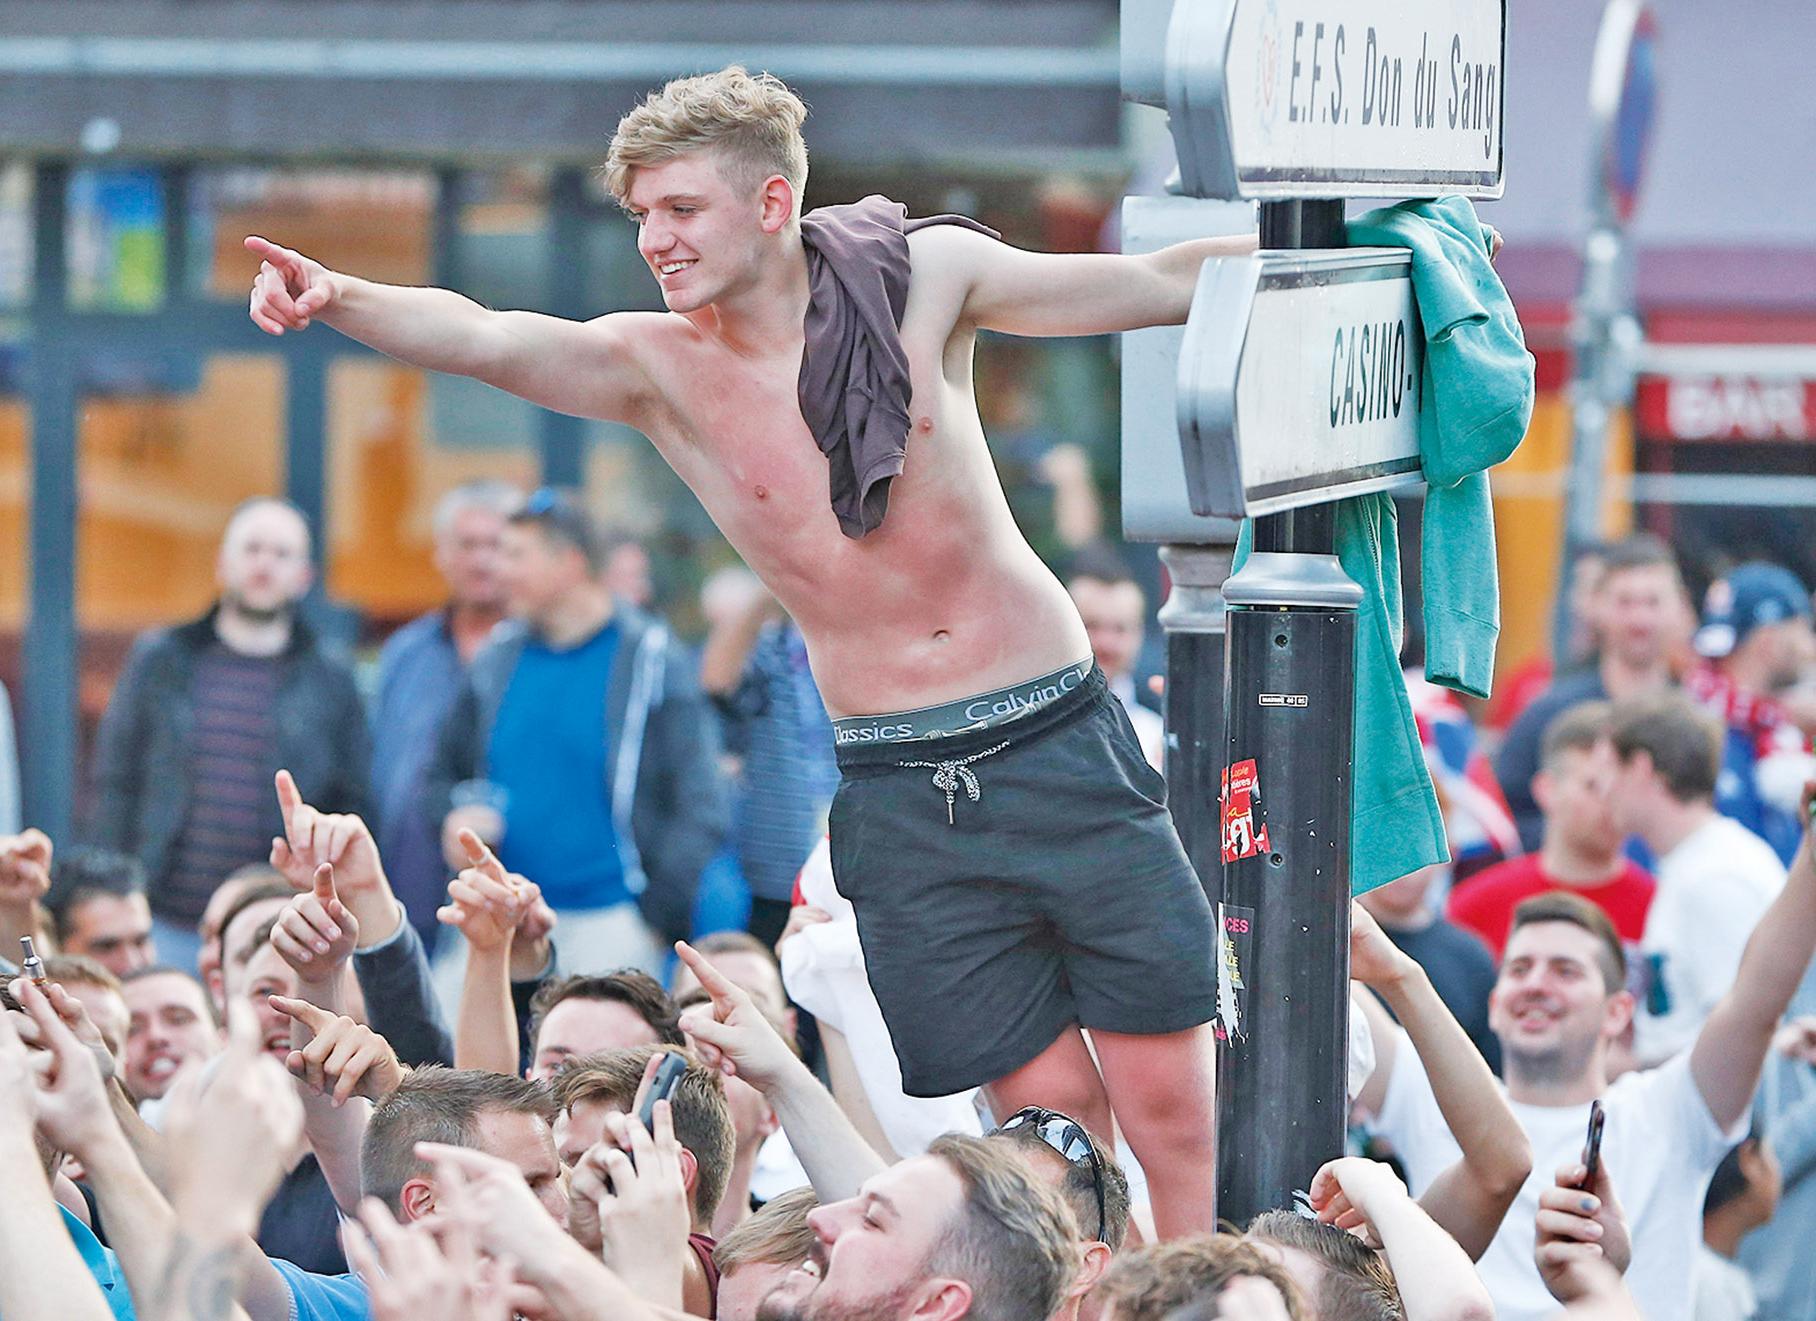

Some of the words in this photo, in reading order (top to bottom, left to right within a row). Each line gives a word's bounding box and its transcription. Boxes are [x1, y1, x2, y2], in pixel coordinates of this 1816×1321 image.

[1289, 21, 1348, 124] E.F.S.
[1362, 27, 1401, 127] Don
[1414, 32, 1437, 129] du
[1448, 34, 1496, 159] Sang
[1667, 373, 1805, 440] BAR
